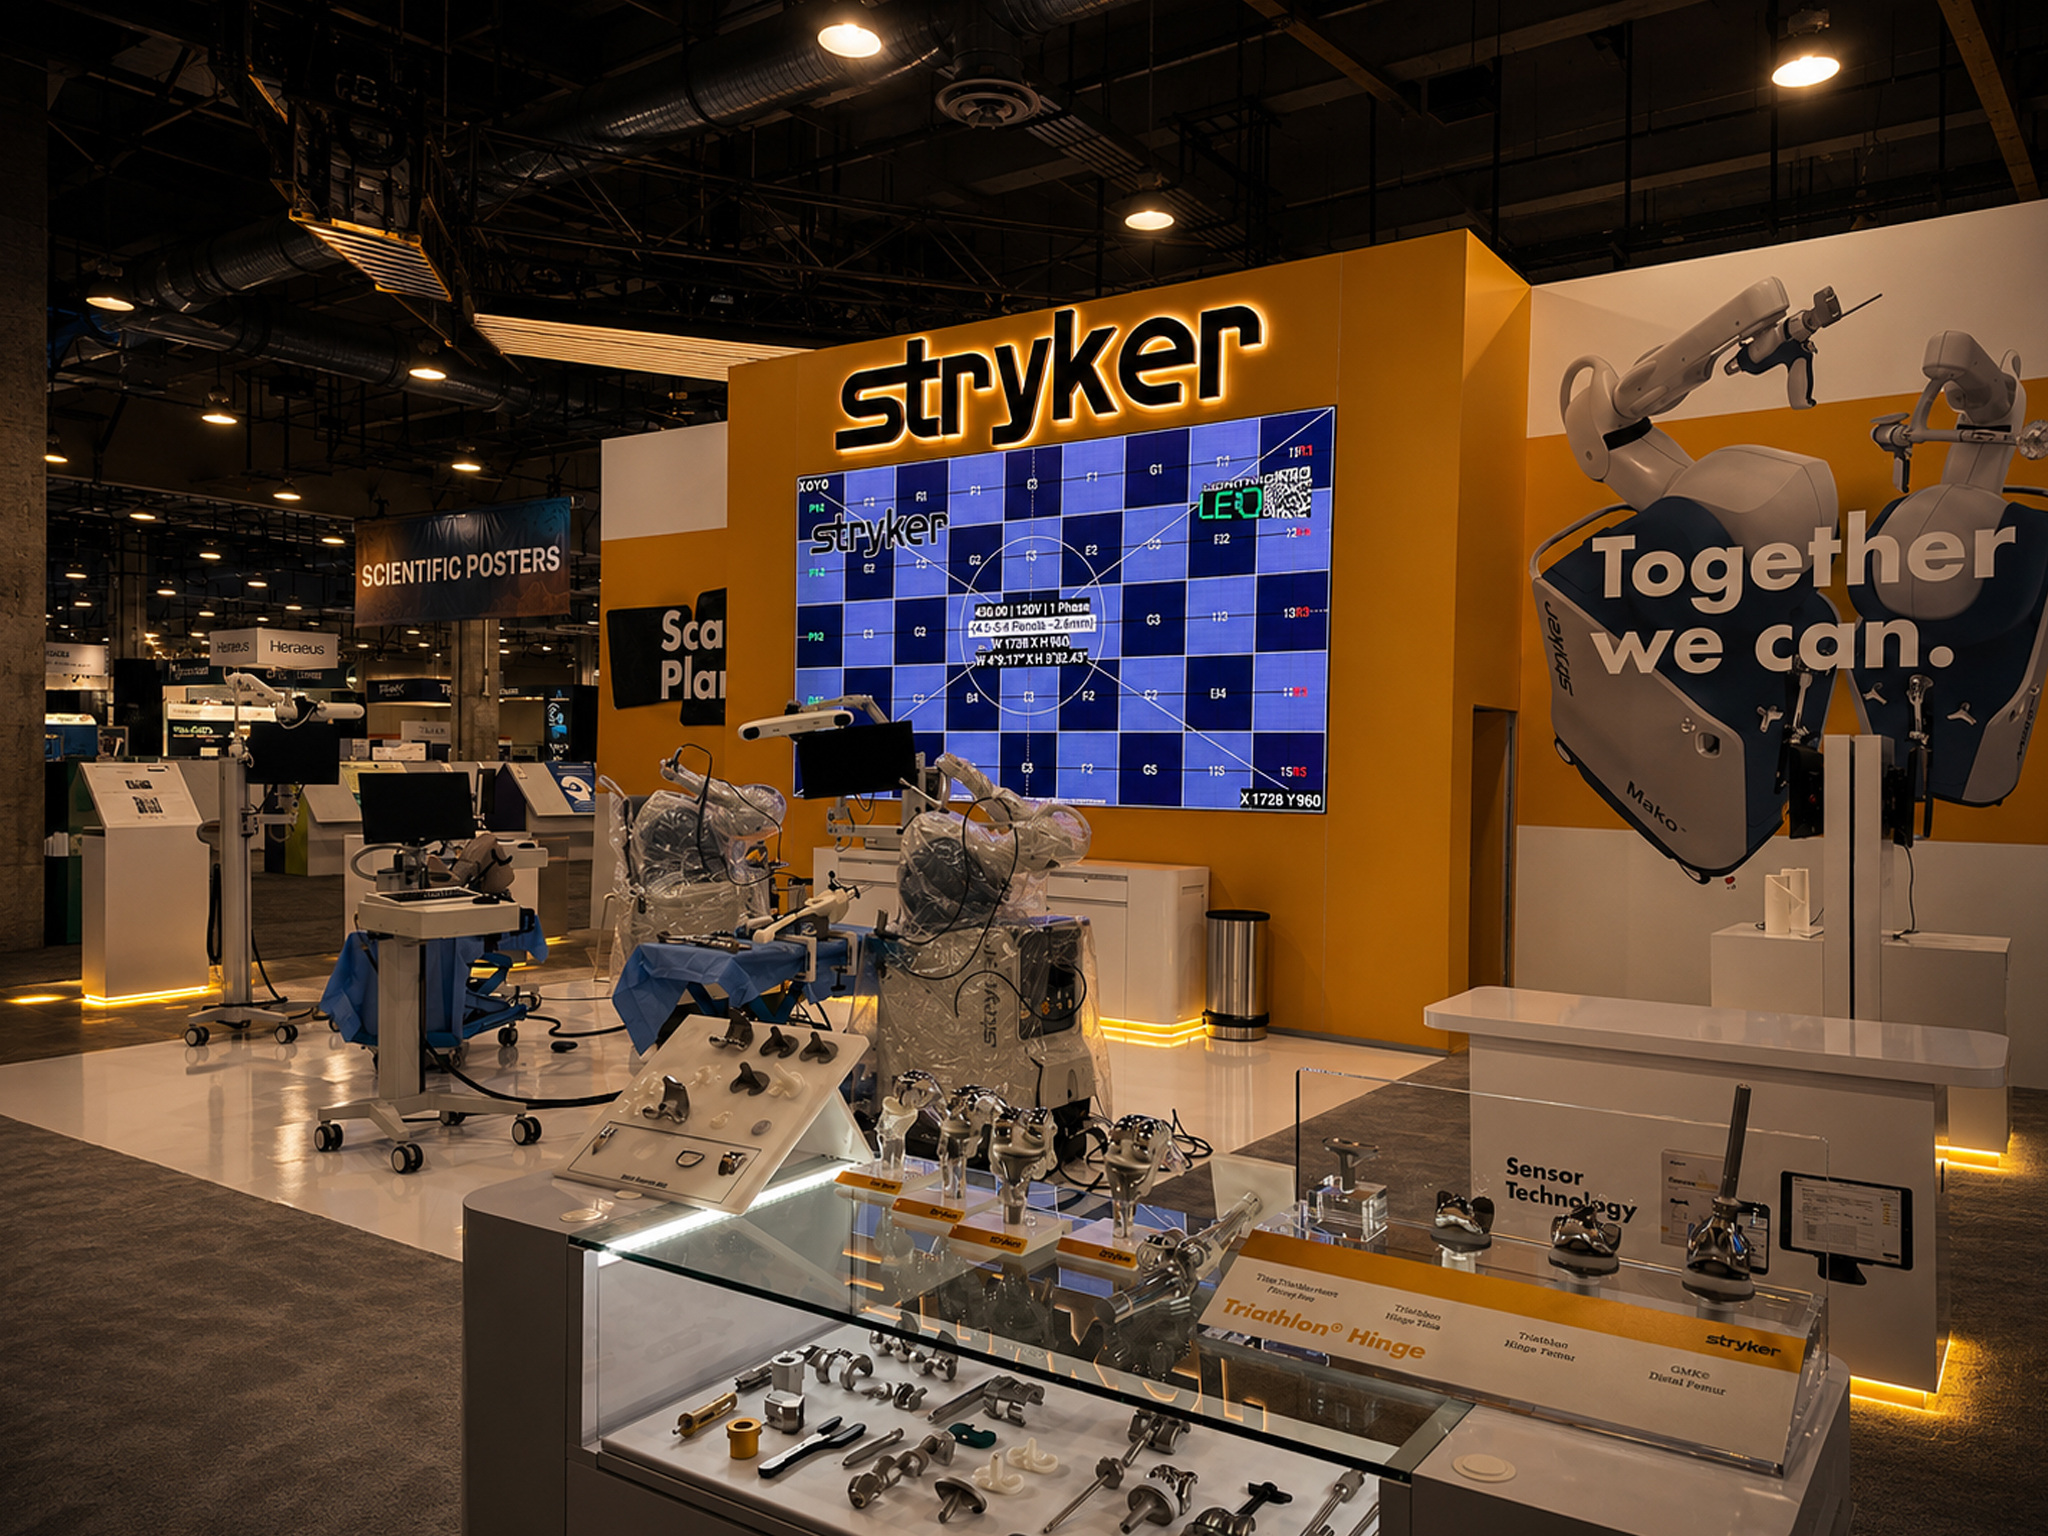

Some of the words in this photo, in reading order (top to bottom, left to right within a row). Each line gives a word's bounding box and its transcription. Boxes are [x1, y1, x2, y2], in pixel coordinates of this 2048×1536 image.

[834, 308, 1264, 451] stryker
[810, 508, 949, 558] stryker
[362, 555, 461, 588] SCIENTIFIC
[466, 545, 561, 579] POSTERS
[1591, 510, 2016, 614] Together
[1016, 604, 1042, 616] 120V
[270, 640, 325, 655] Heraeus
[1590, 626, 1723, 675] we
[1755, 617, 1955, 673] can.
[1252, 792, 1284, 806] 1728
[1626, 780, 1678, 833] Mako
[1506, 1156, 1584, 1186] Sensor
[1346, 1327, 1426, 1361] Hinge
[1705, 1334, 1782, 1357] stryker
